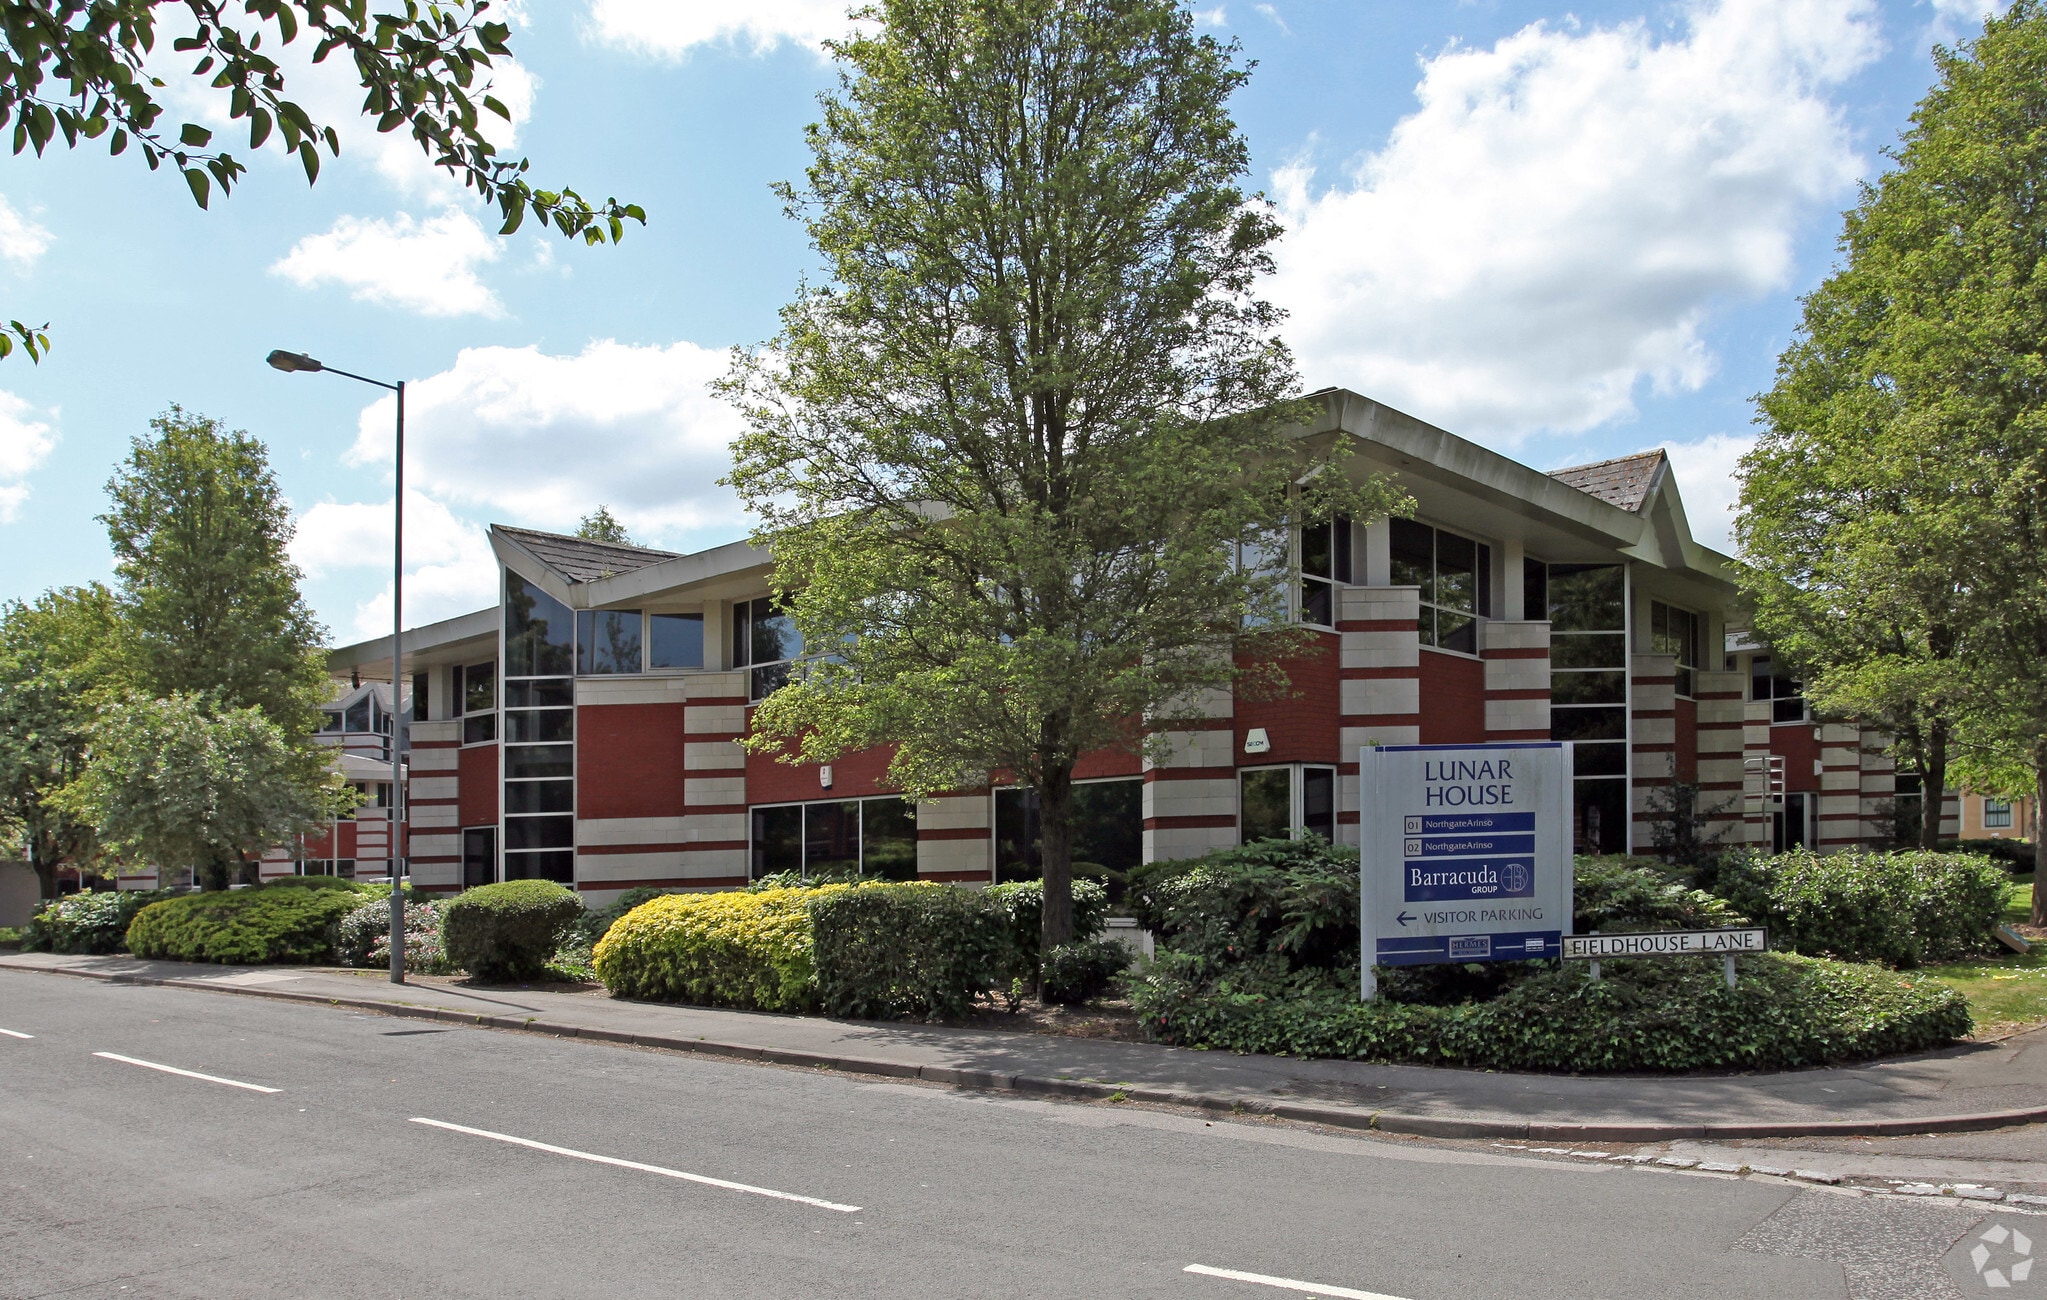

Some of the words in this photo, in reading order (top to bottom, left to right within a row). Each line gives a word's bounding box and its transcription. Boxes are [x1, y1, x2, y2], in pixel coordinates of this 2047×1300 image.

[1425, 760, 1514, 781] LUNAR
[1426, 784, 1514, 806] HOUSE
[1407, 821, 1419, 830] 01
[1425, 819, 1493, 830] NorthgateArinso
[1407, 843, 1419, 853] 02
[1425, 842, 1493, 852] NorthgateArinso
[1411, 865, 1498, 887] Barracuda
[1471, 886, 1498, 894] GROUP
[1424, 911, 1477, 924] VISITOR
[1481, 908, 1543, 922] PARKING
[1452, 940, 1488, 949] HERMES
[1573, 936, 1689, 954] FIELDHOUSE
[1702, 933, 1754, 950] LANE
